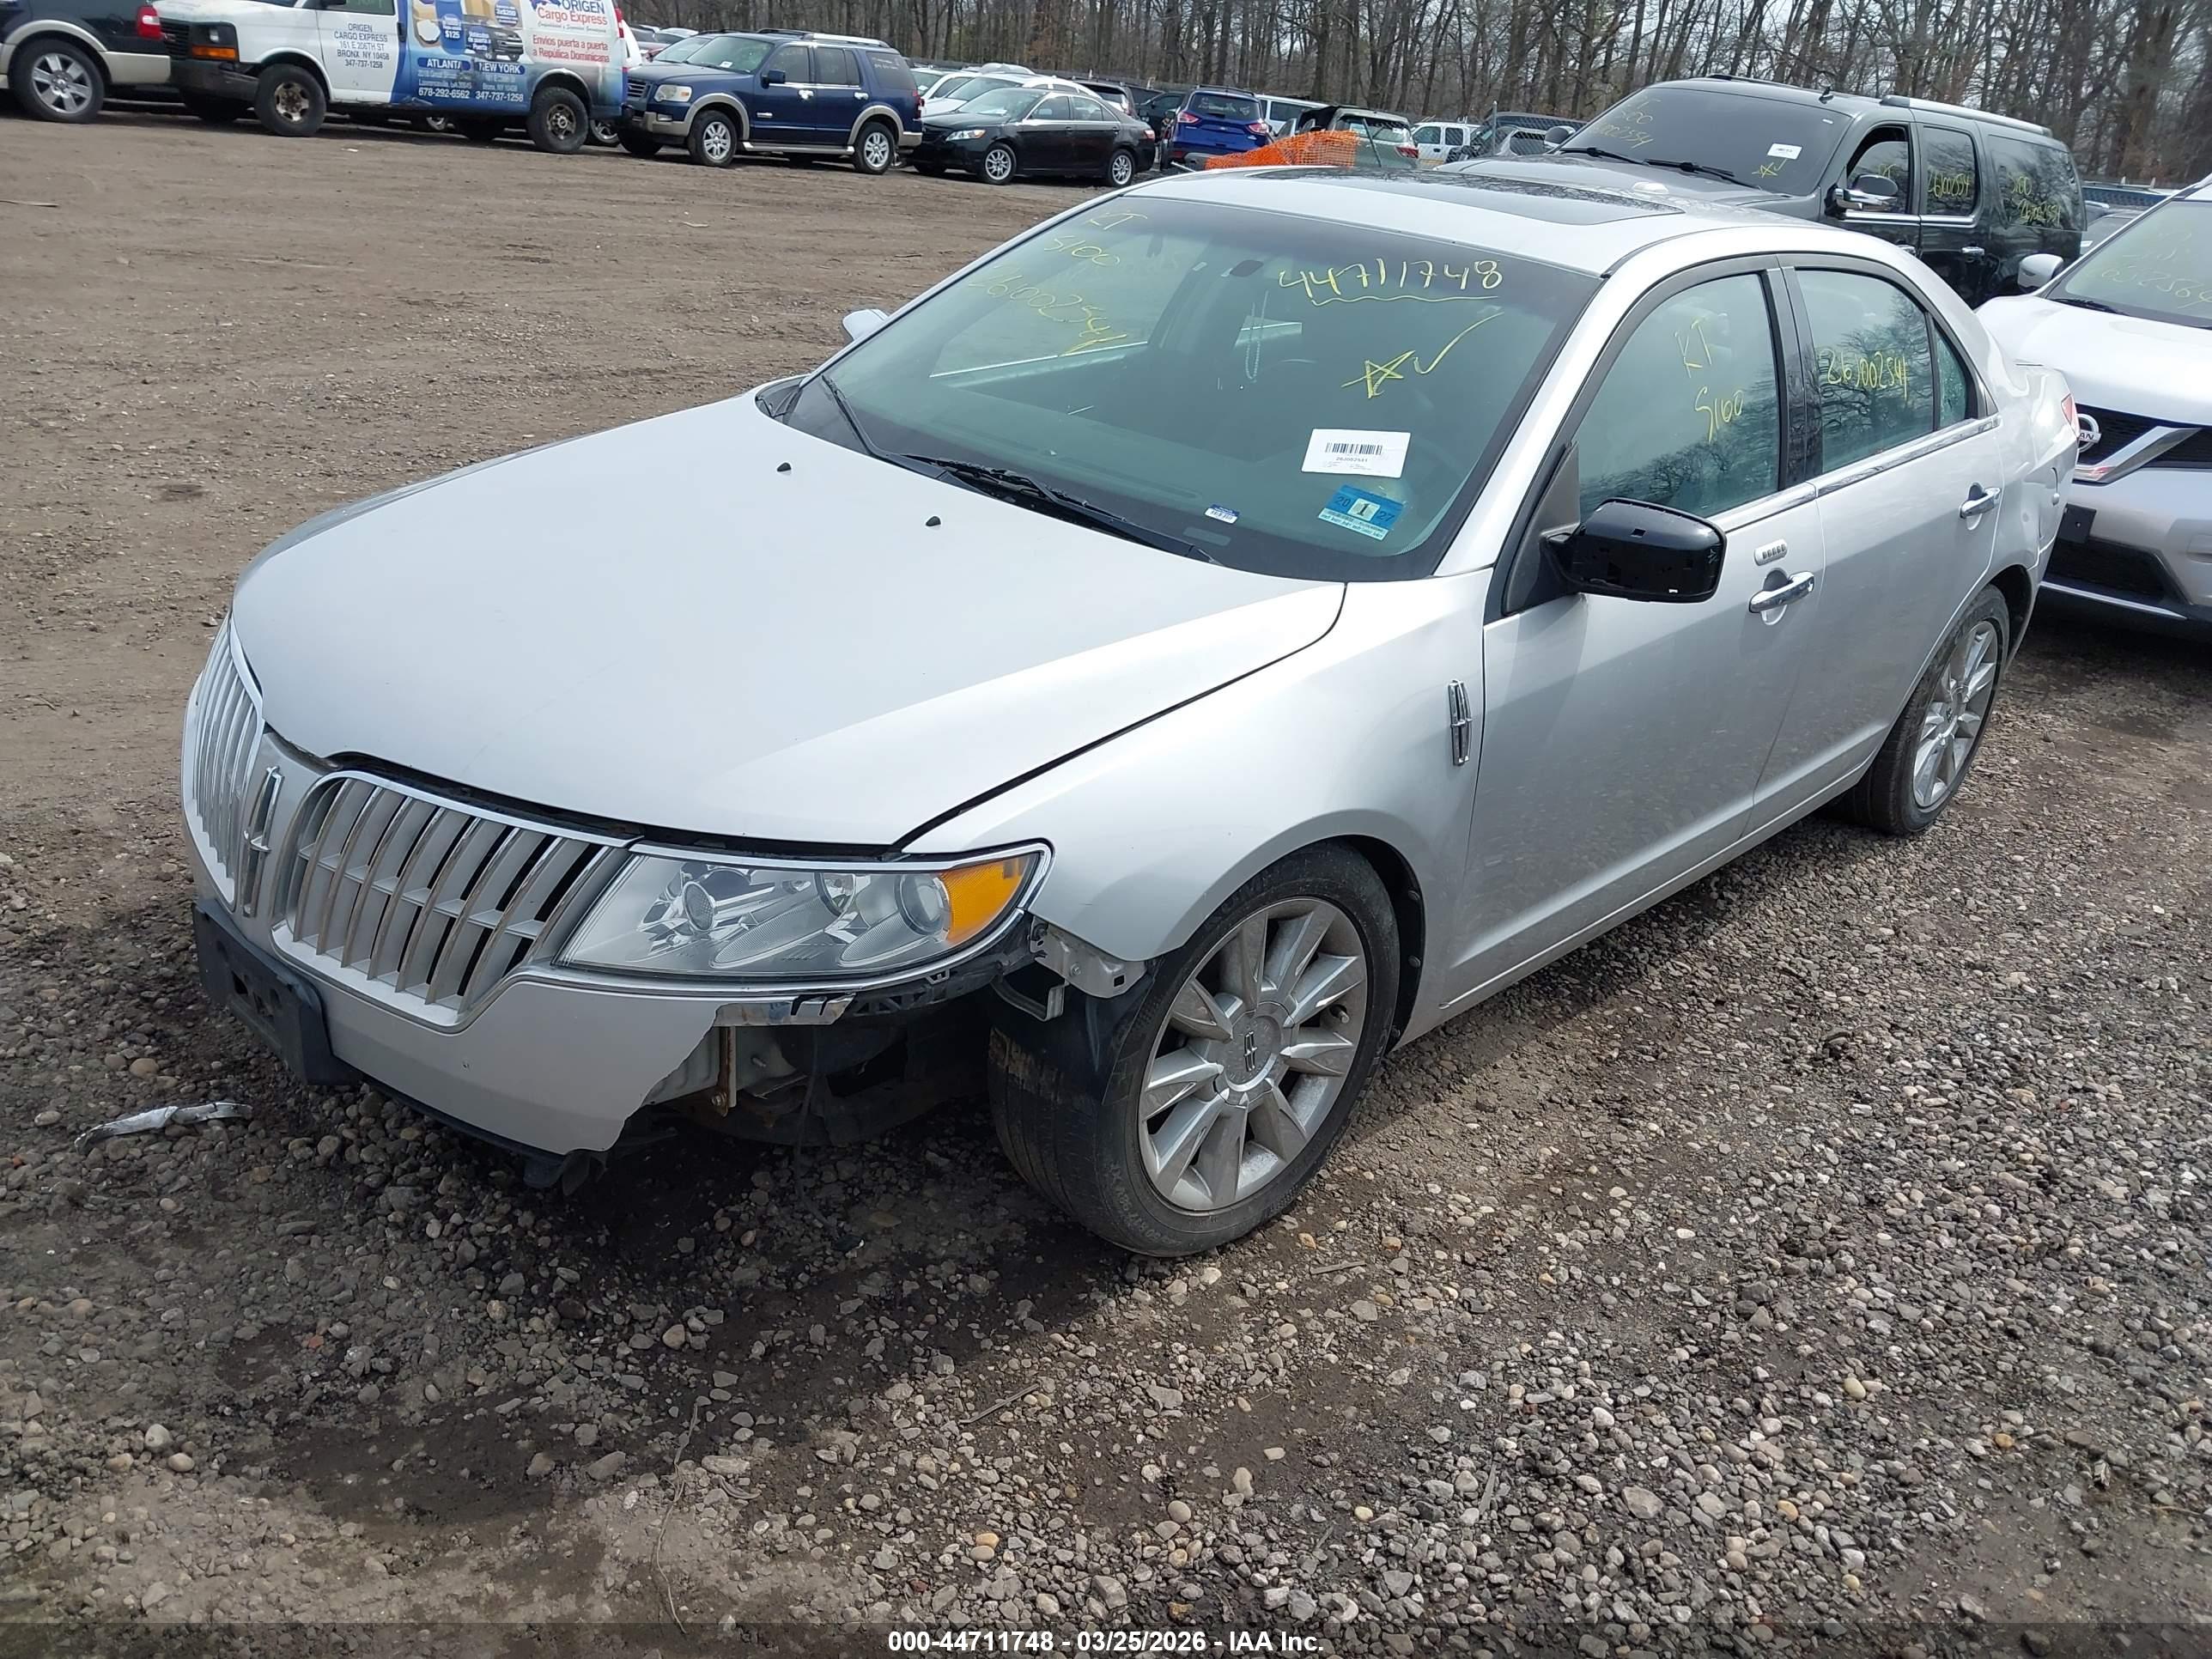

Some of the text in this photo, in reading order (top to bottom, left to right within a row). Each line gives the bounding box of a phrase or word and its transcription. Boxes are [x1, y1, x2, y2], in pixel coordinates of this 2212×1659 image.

[562, 0, 605, 14] ORIGEN
[538, 7, 608, 26] Cargo Express
[348, 22, 373, 33] ORIGEN
[334, 30, 388, 42] CARGO EXPRESS
[445, 30, 460, 39] $125
[377, 43, 385, 52] ST
[557, 37, 580, 49] puerta
[586, 40, 609, 51] puerta
[337, 49, 360, 58] BRONX
[362, 51, 372, 59] NY
[570, 50, 611, 63] Dominicana
[498, 64, 521, 74] YORK
[1278, 257, 1504, 299] 44711748
[1336, 495, 1395, 522] 20 1 27
